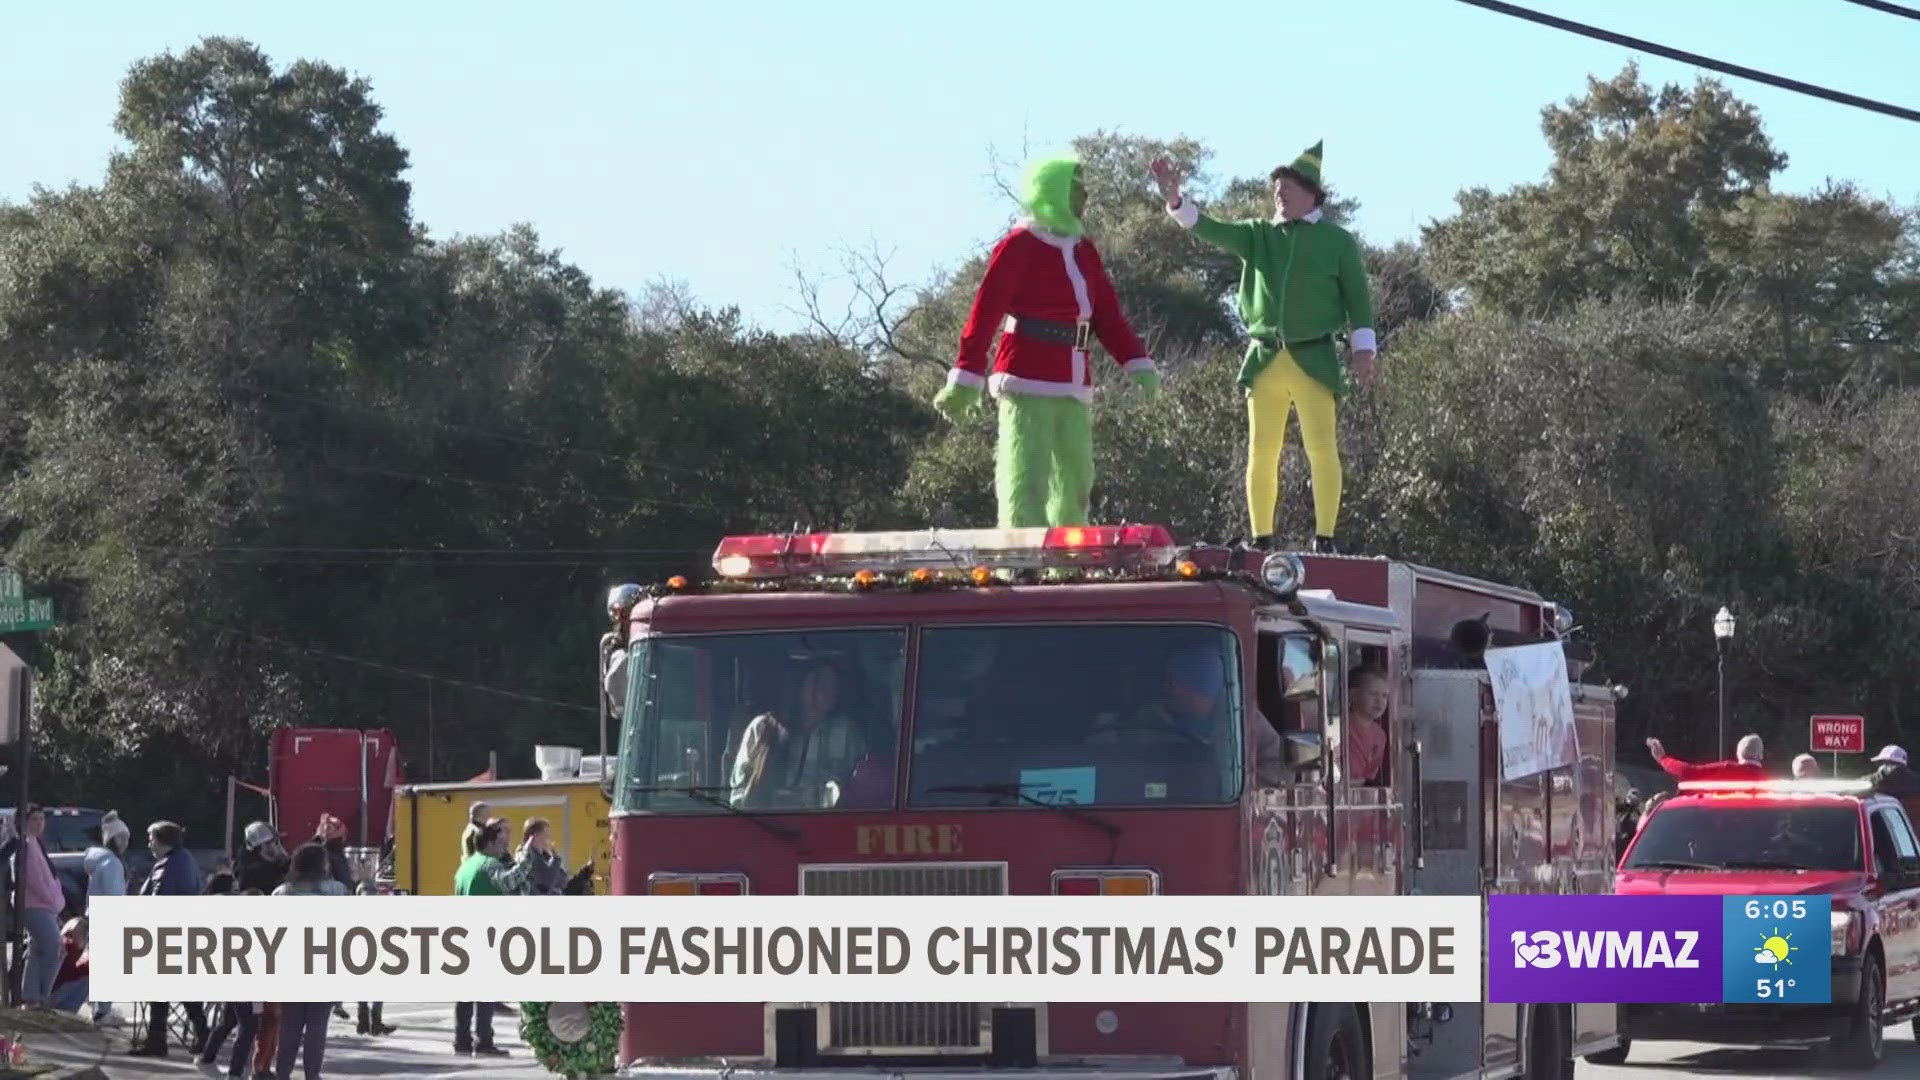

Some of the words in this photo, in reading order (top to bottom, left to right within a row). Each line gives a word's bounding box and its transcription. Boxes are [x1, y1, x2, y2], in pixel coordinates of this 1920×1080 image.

[29, 598, 51, 621] Blvd
[1817, 722, 1857, 735] WRONG
[1825, 735, 1849, 747] WAY
[857, 825, 962, 855] FIRE
